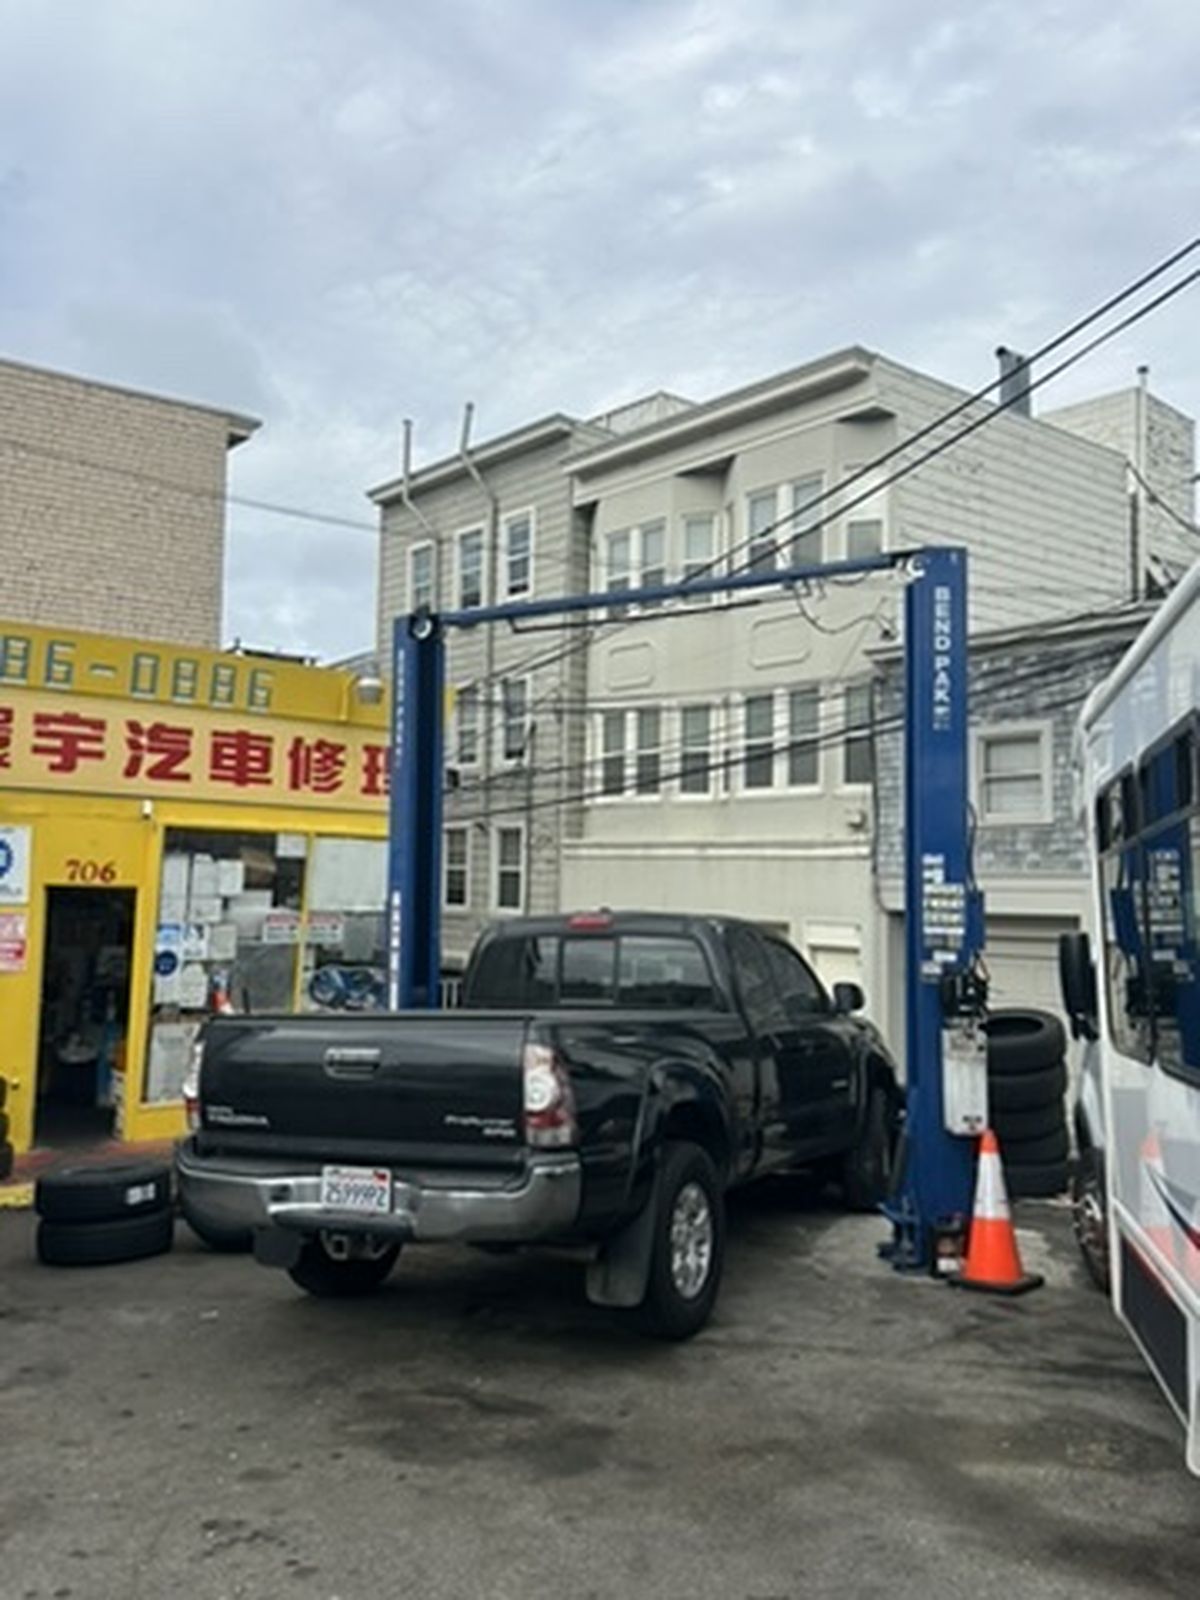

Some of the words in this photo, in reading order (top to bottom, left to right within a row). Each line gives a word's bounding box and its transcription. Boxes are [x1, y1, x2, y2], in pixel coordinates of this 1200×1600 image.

[0, 707, 391, 796] 宇汽車修理
[66, 858, 117, 882] 706
